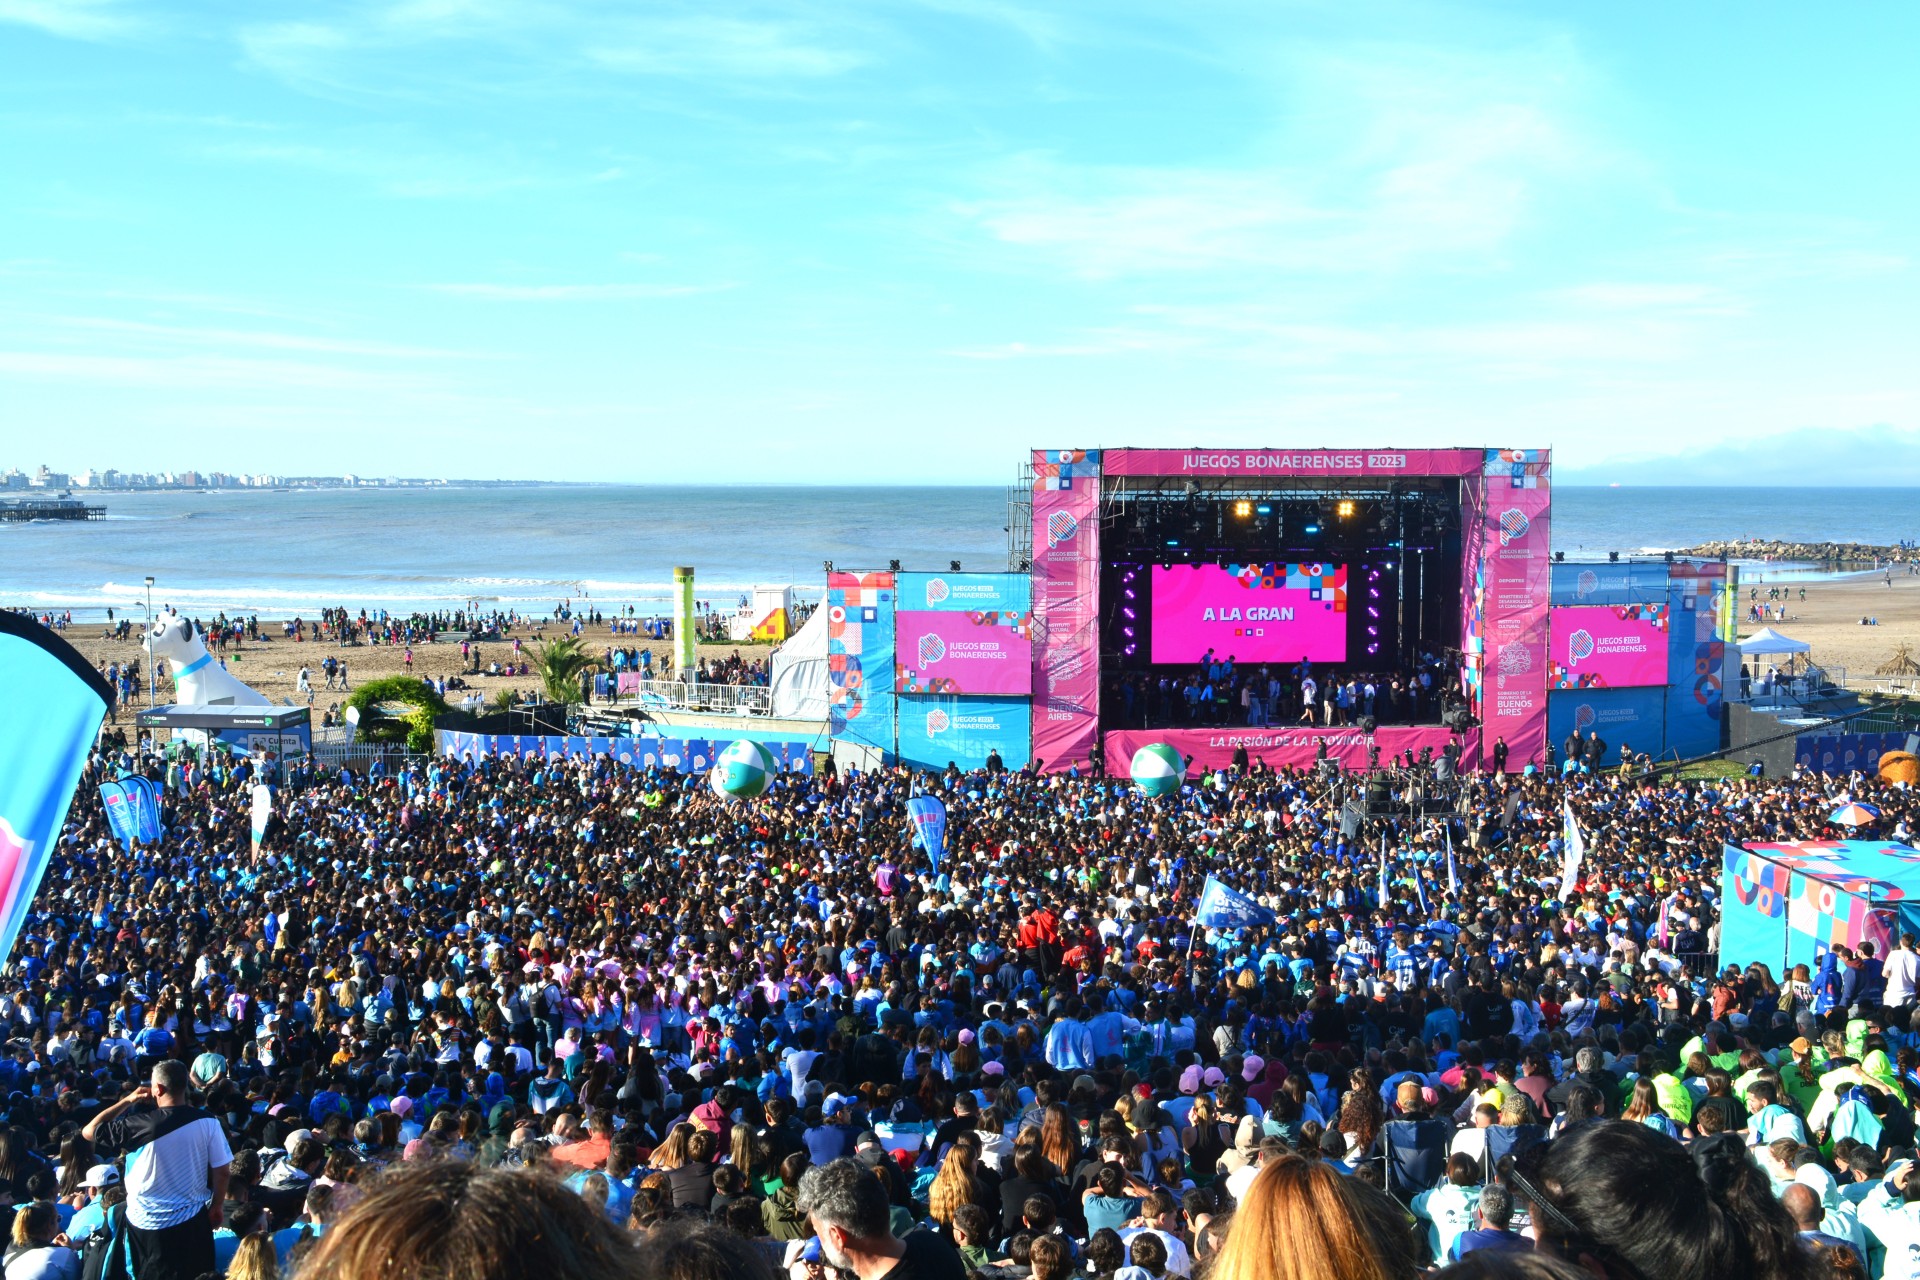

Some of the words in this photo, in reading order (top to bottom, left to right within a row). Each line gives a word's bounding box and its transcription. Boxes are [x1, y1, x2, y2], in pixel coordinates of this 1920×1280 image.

[1183, 455, 1240, 470] JUEGOS
[1245, 455, 1363, 469] BONAERENSES
[1370, 455, 1404, 467] 2025
[1203, 608, 1216, 621] A
[1220, 608, 1242, 621] LA
[1246, 607, 1295, 621] GRAN
[1597, 637, 1622, 645] JUEGOS
[1624, 636, 1640, 644] 2025
[1597, 645, 1646, 653] BONAERENSES
[1498, 700, 1532, 708] BUENOS
[1048, 705, 1083, 713] BUENOS
[1497, 708, 1522, 716] AIRES
[1210, 737, 1225, 747] LA
[1228, 734, 1272, 747] PASIÓN
[1275, 737, 1290, 746] DE
[1293, 736, 1308, 746] LA
